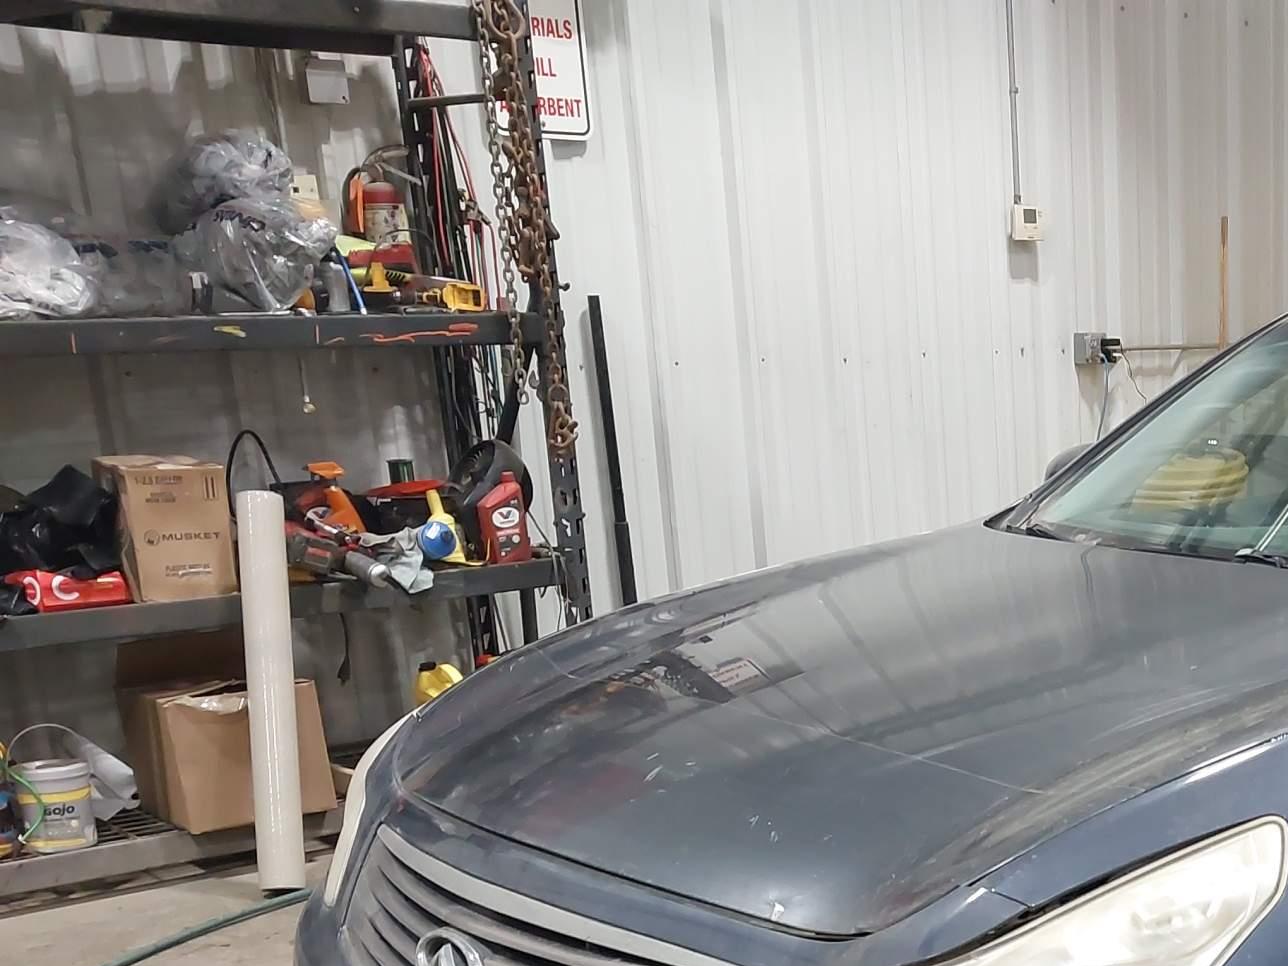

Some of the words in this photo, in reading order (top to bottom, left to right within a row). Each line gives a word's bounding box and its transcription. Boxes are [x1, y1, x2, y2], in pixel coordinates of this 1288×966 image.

[531, 17, 573, 39] RIALS
[535, 57, 557, 78] ILL
[161, 531, 221, 542] MUSKET
